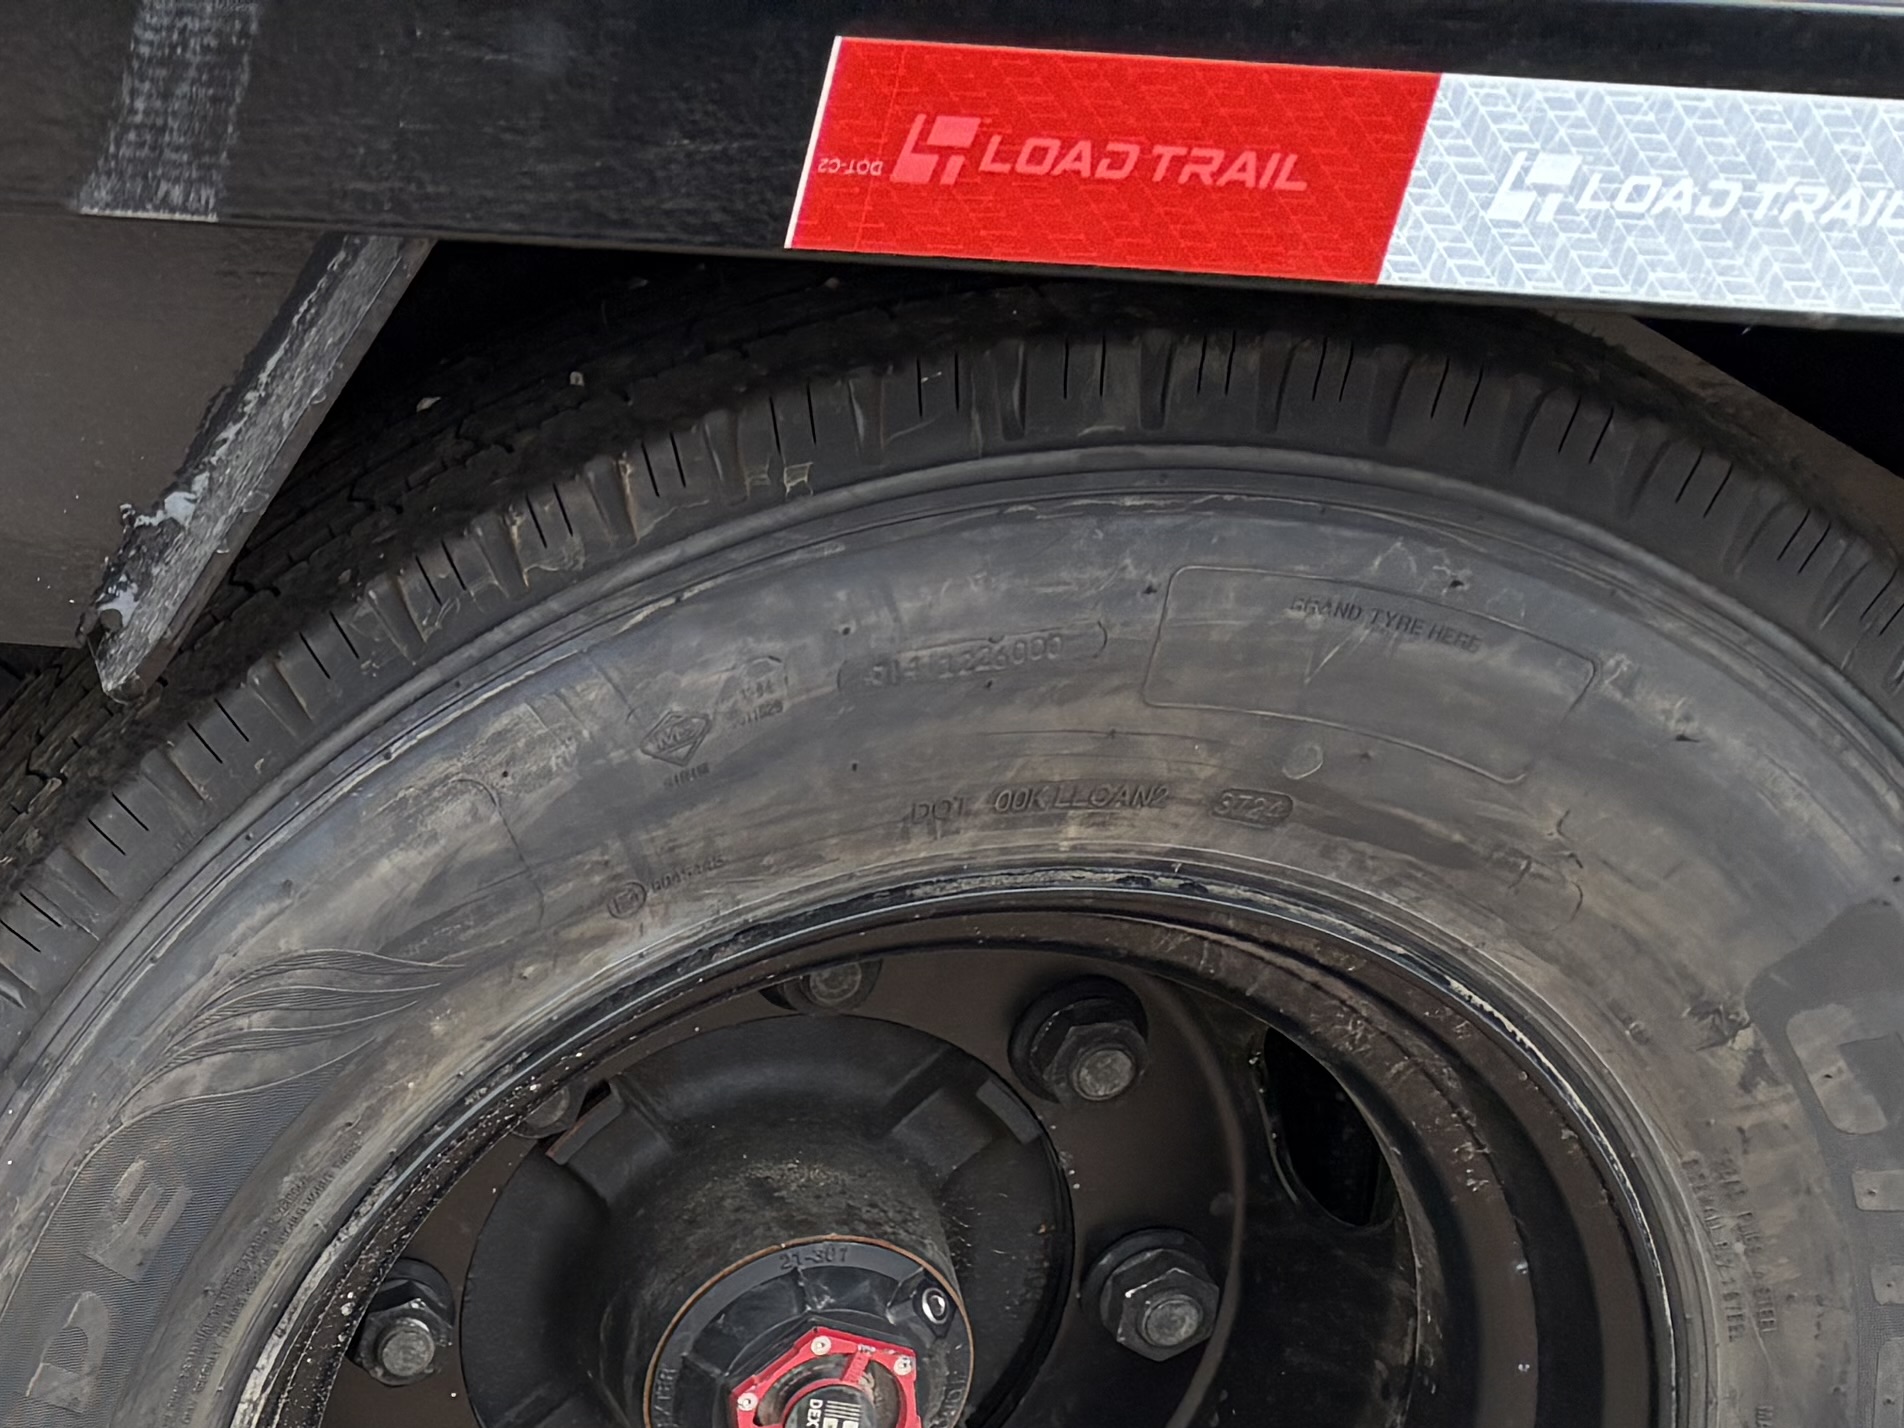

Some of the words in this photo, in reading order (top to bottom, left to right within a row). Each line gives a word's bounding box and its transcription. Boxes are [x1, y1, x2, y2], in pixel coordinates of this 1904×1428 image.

[818, 157, 884, 176] DOT-C2
[979, 134, 1140, 180] LOAD
[1151, 144, 1308, 191] TRAIL
[1576, 173, 1743, 219] LOAD
[1370, 606, 1424, 636] TYRE
